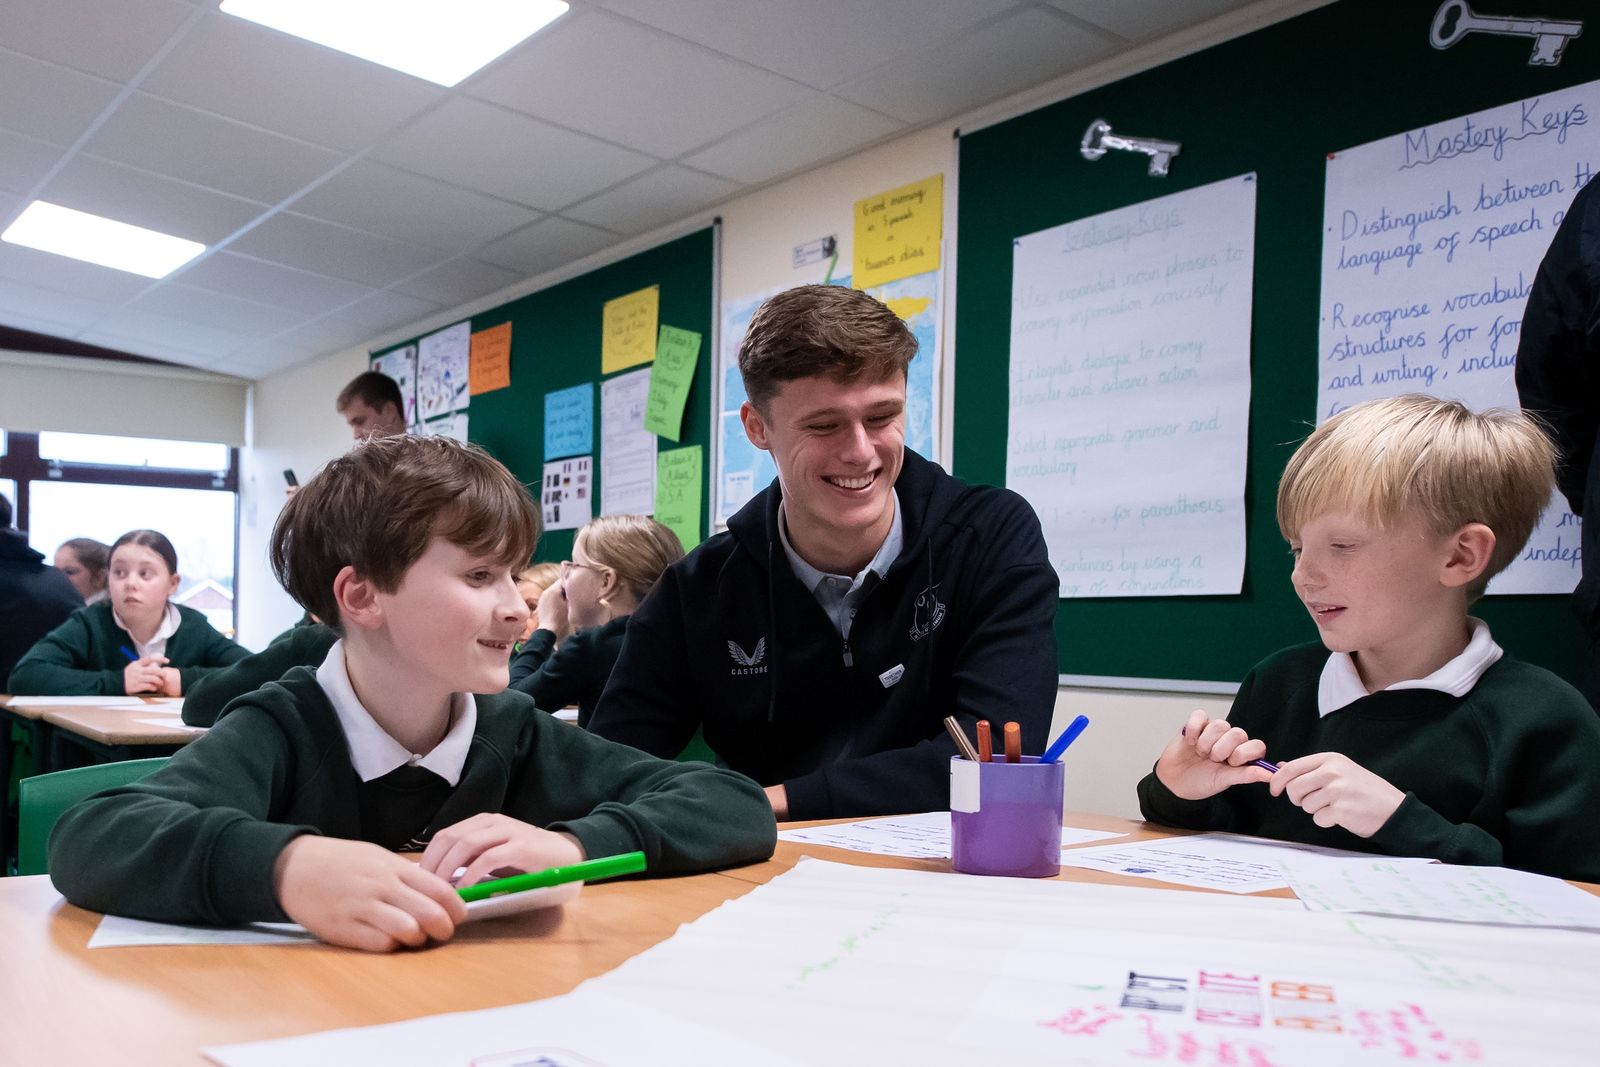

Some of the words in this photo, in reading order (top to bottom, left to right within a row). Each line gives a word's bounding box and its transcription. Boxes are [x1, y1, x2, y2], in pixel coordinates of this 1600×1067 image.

[1404, 117, 1508, 162] Mastery
[1521, 98, 1586, 144] Keys
[1341, 190, 1463, 241] Distinguish
[1472, 182, 1566, 213] between
[1337, 241, 1424, 275] language
[1433, 231, 1461, 263] of
[1468, 207, 1544, 251] speech
[1331, 300, 1432, 334] Recognise
[1328, 331, 1427, 363] structures
[1437, 322, 1480, 358] for
[1327, 364, 1365, 391] and
[1186, 408, 1222, 435] and
[1112, 504, 1133, 531] for
[1140, 493, 1227, 527] parenthesis
[1119, 546, 1139, 577] by
[1188, 553, 1205, 570] a
[731, 665, 768, 675] CASTORE
